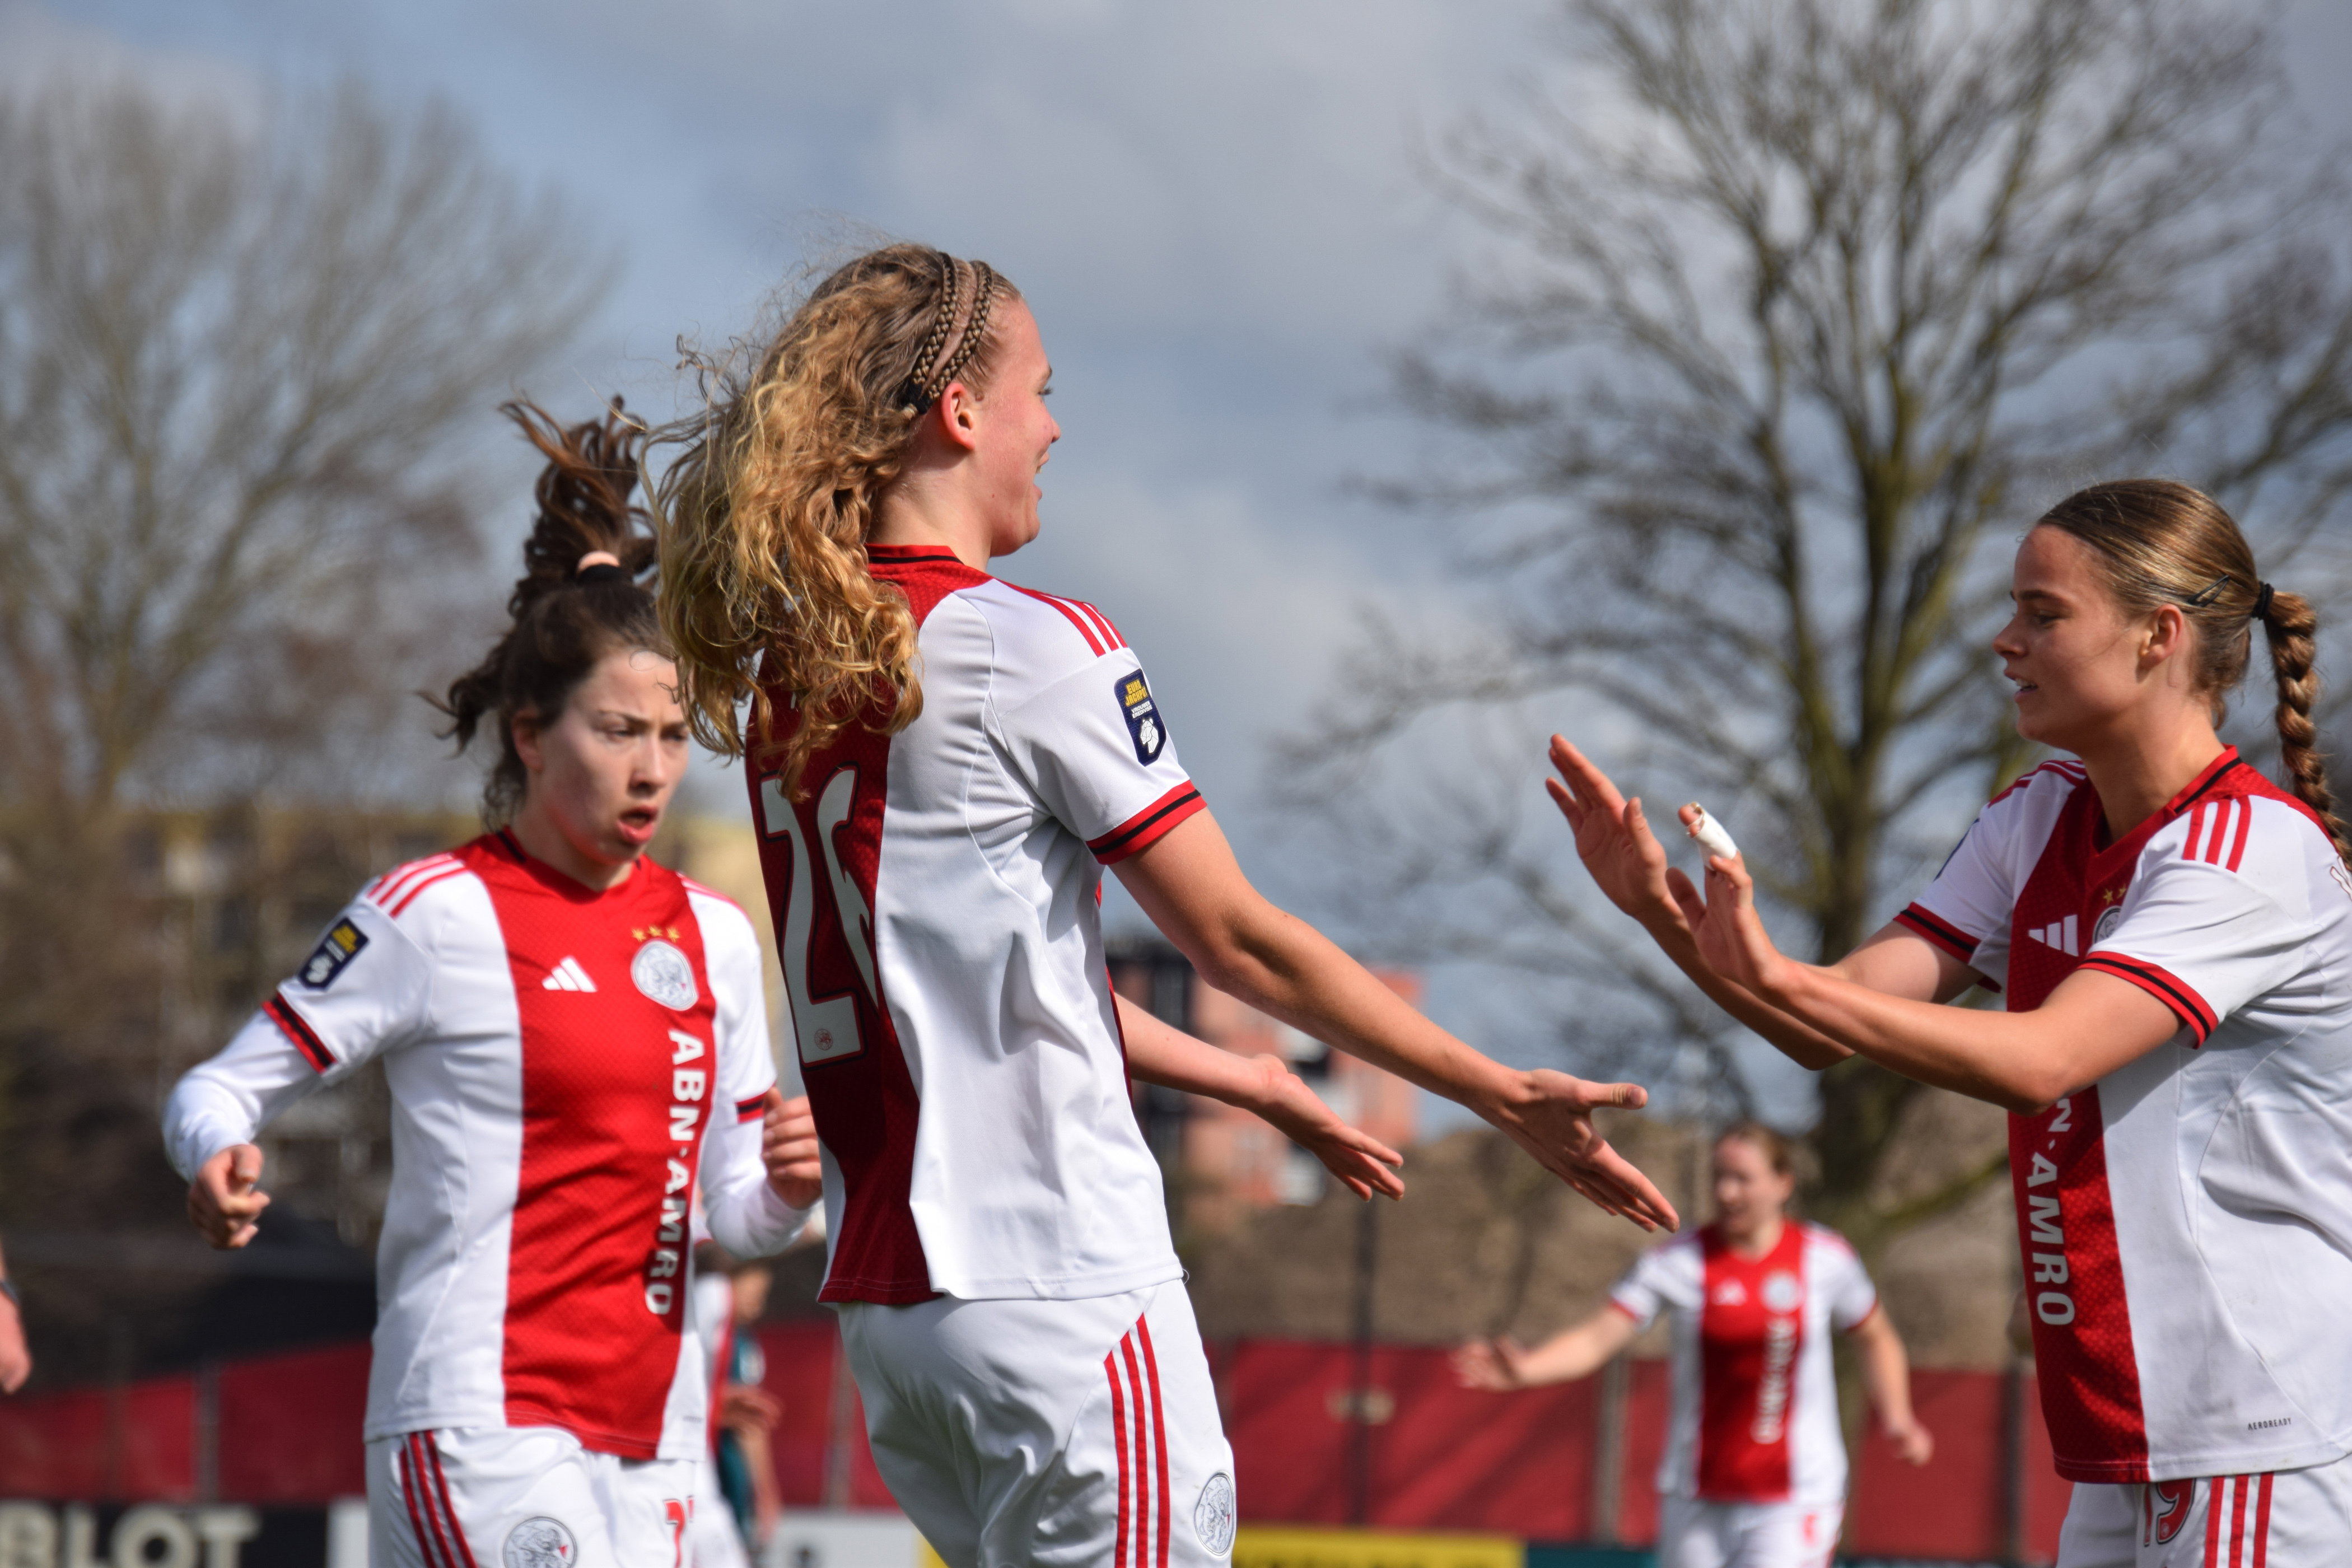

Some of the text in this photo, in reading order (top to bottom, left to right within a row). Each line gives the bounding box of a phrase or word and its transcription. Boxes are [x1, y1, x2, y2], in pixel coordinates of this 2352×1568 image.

[1126, 679, 1142, 694] EURO
[1126, 687, 1148, 707] JACKPOT
[2248, 1417, 2292, 1431] AEROREADY
